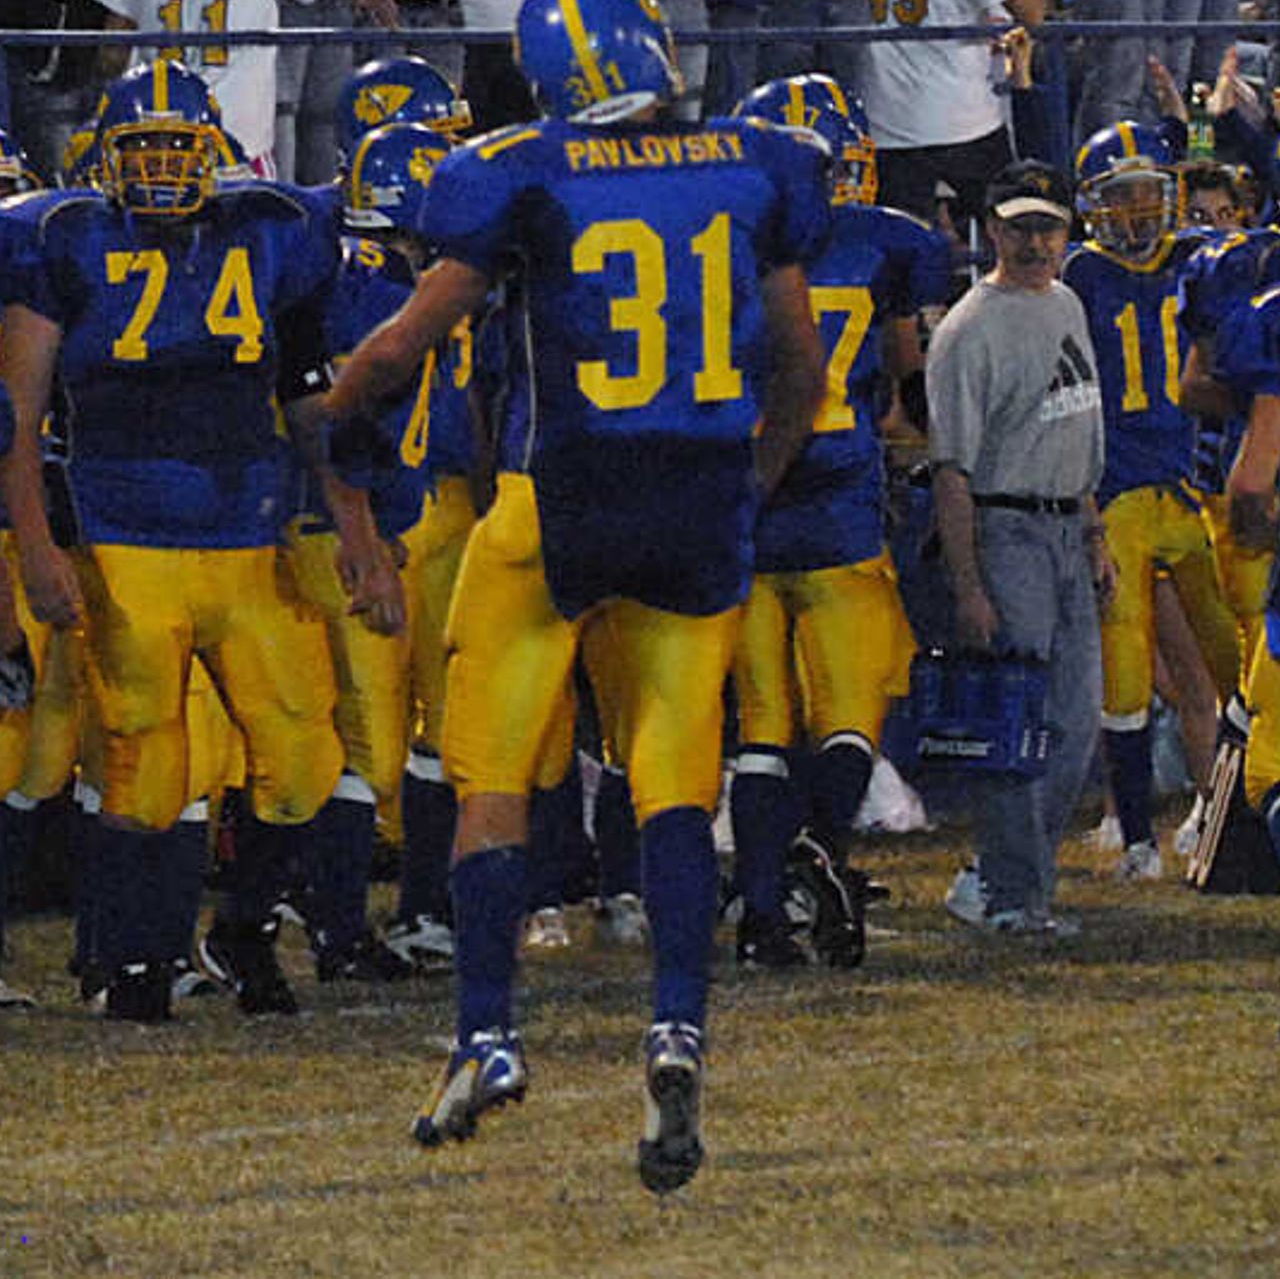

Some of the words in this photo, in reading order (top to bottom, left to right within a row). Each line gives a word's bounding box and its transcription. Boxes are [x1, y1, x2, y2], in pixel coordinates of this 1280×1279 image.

[564, 132, 743, 171] PAVLOVSKY
[104, 247, 266, 363] 74
[571, 213, 744, 411] 31
